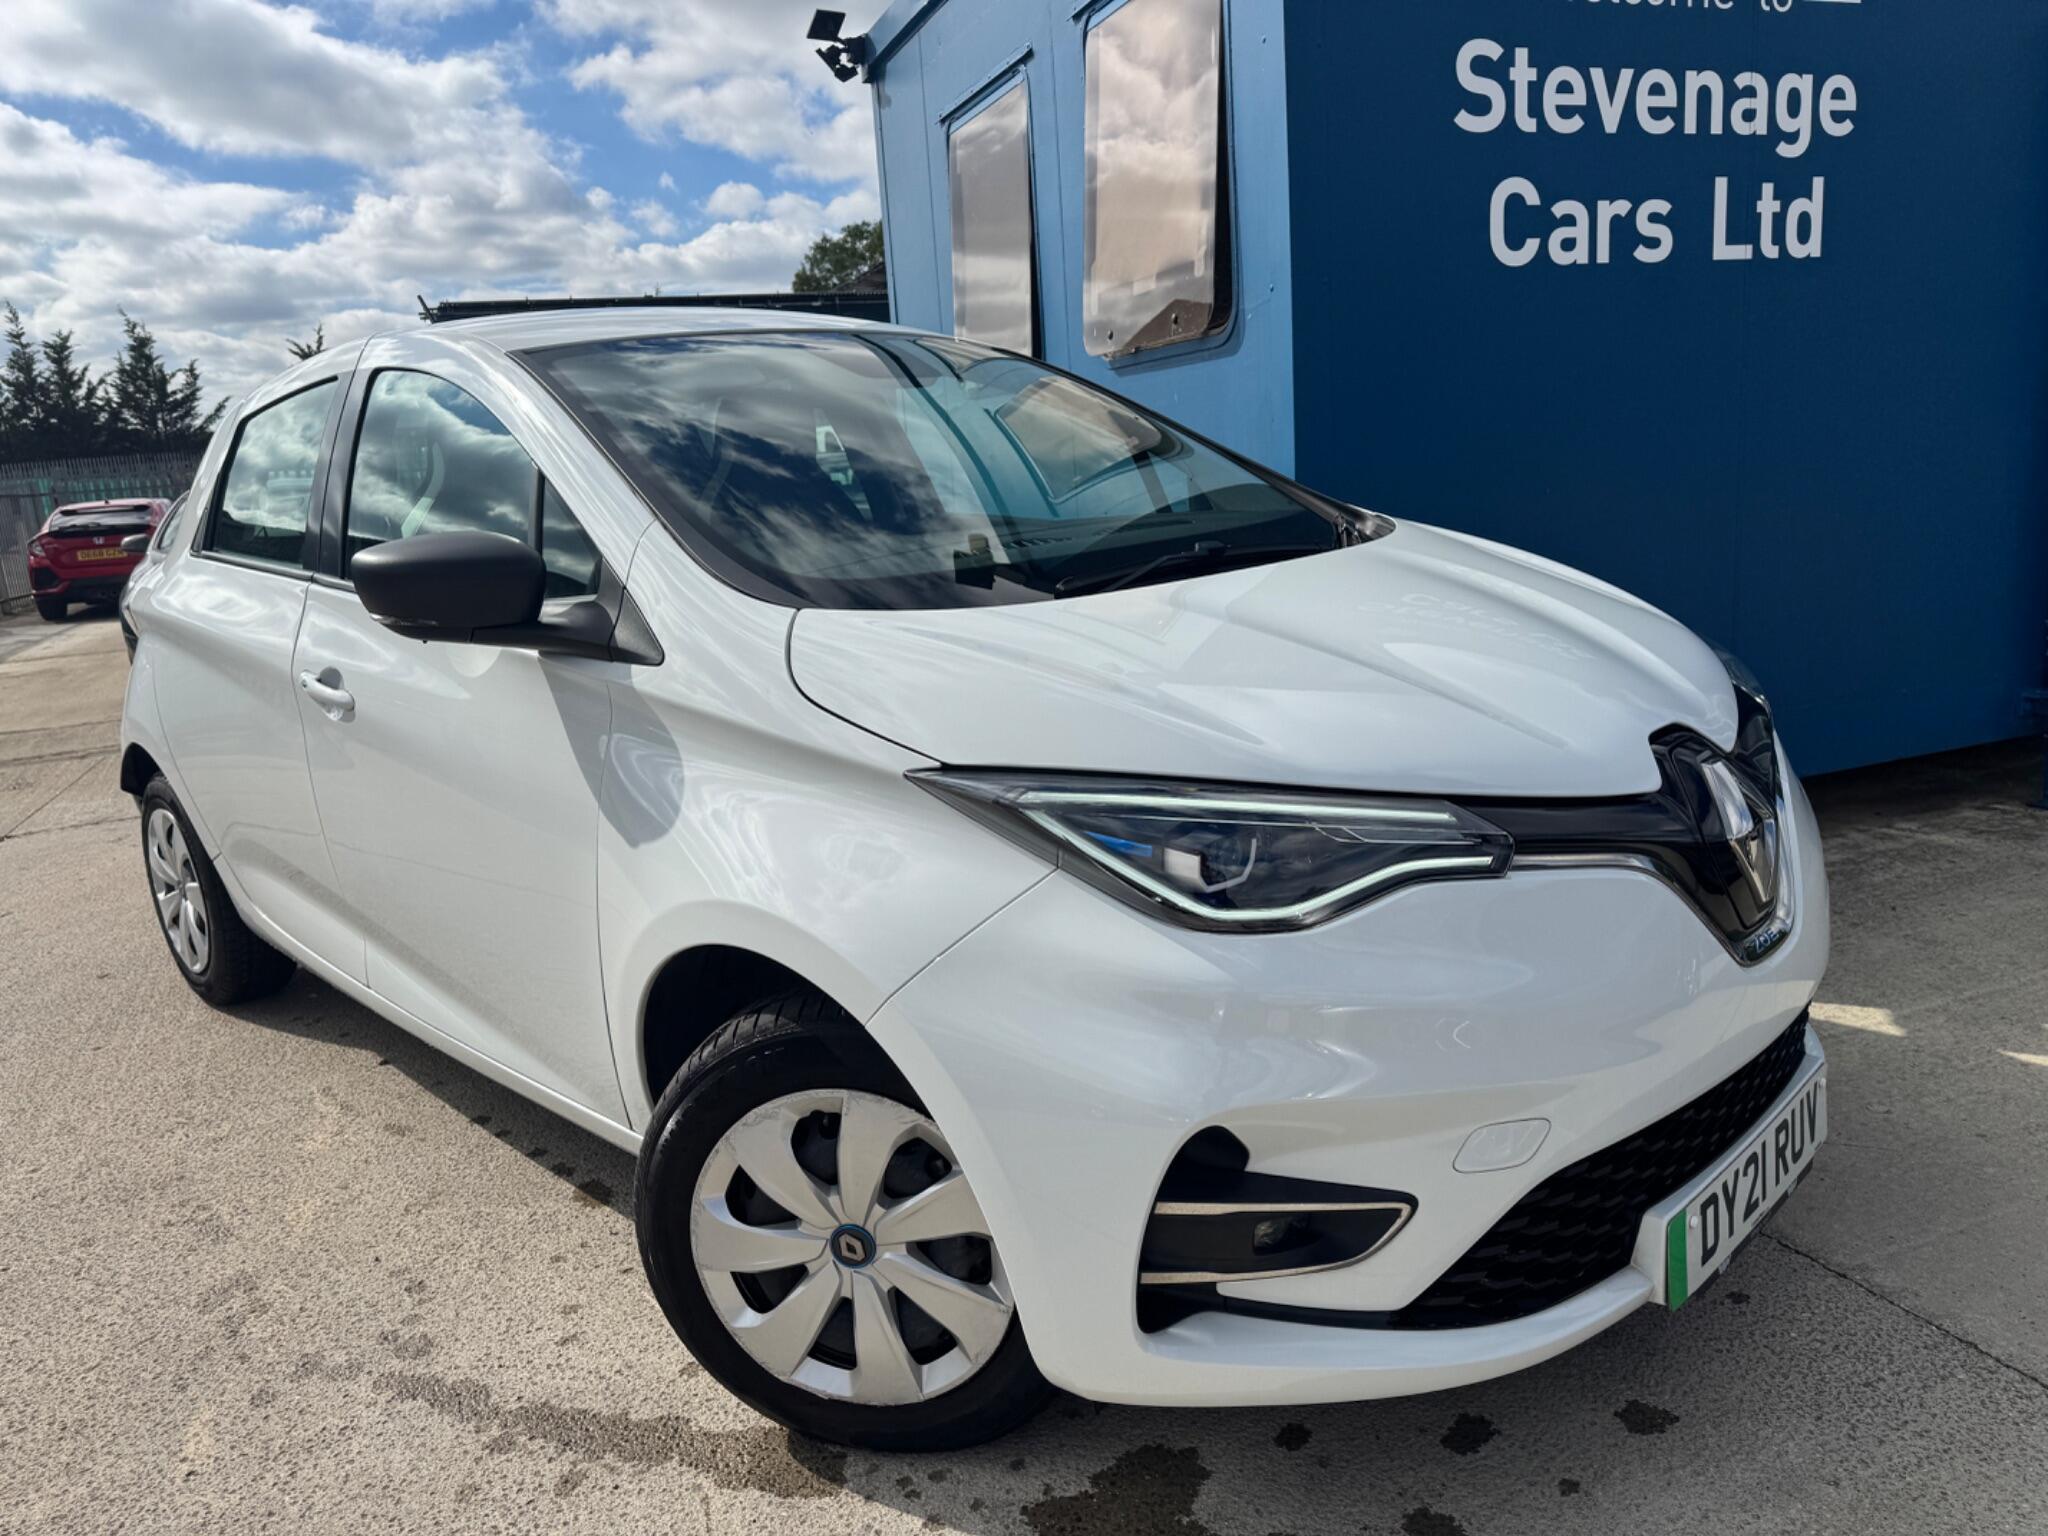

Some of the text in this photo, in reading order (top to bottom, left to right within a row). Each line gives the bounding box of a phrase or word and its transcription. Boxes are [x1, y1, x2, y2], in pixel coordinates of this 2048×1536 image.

[1453, 38, 1857, 158] Stevenage
[1489, 176, 1825, 267] Cars Ltd
[1700, 1081, 1818, 1267] DY21 RUV
